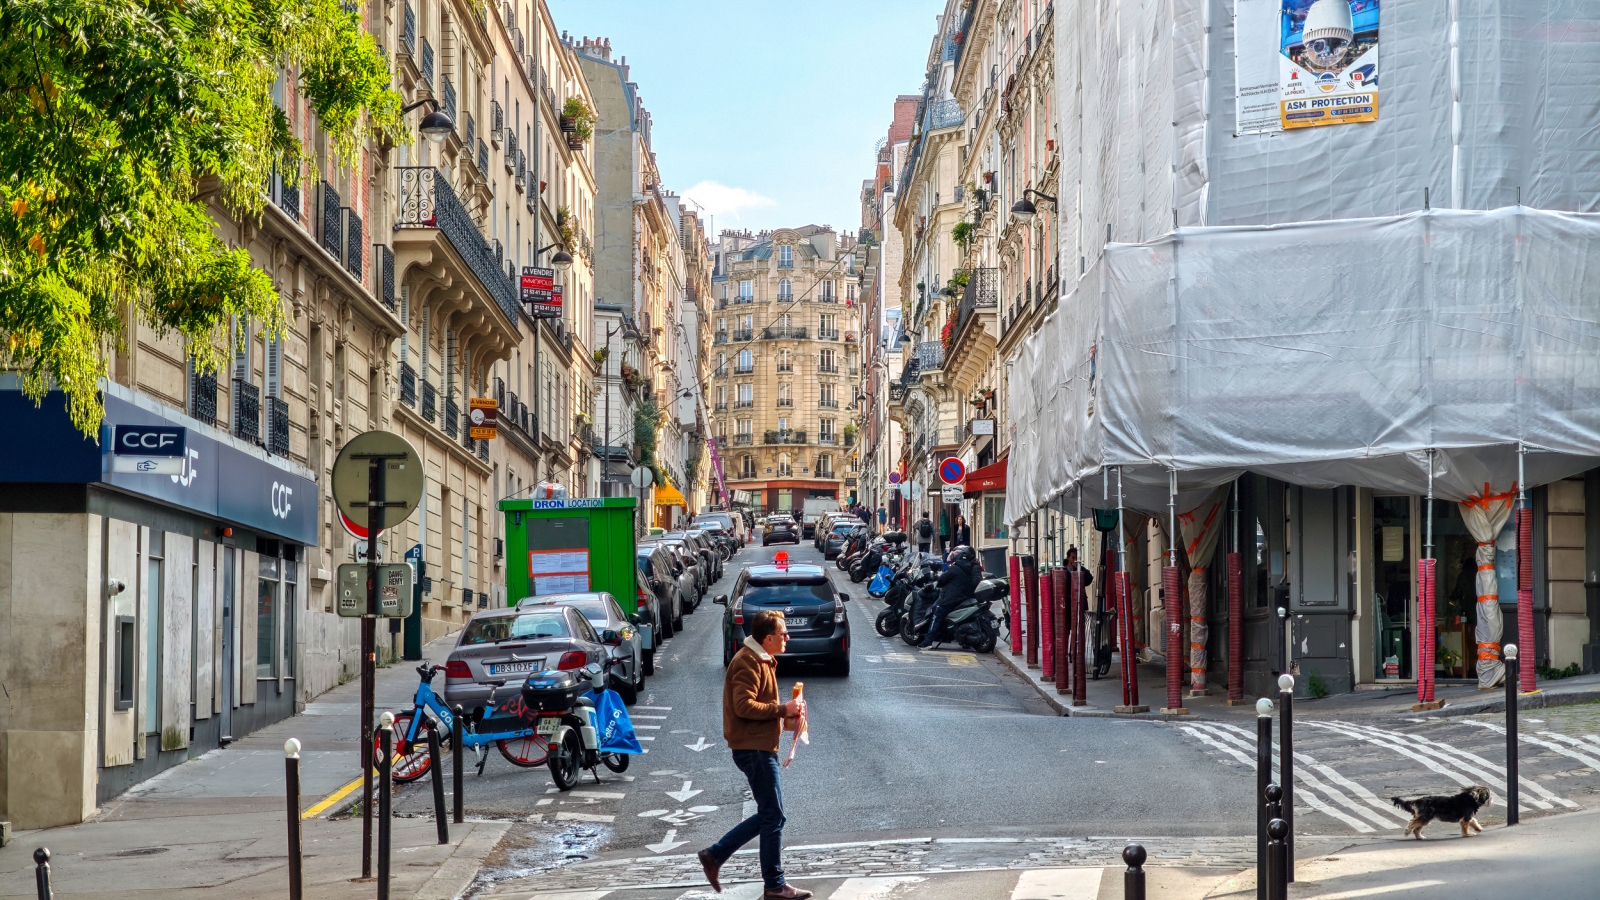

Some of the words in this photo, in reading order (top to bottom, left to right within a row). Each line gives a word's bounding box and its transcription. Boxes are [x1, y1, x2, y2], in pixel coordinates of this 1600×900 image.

[1287, 100, 1306, 110] ASM
[1312, 95, 1370, 107] PROTECTION
[530, 268, 553, 276] VENDRE
[122, 432, 177, 448] CCF
[271, 481, 293, 519] CCF
[534, 500, 564, 509] DRON
[568, 499, 603, 507] LOCATION
[413, 547, 420, 557] P
